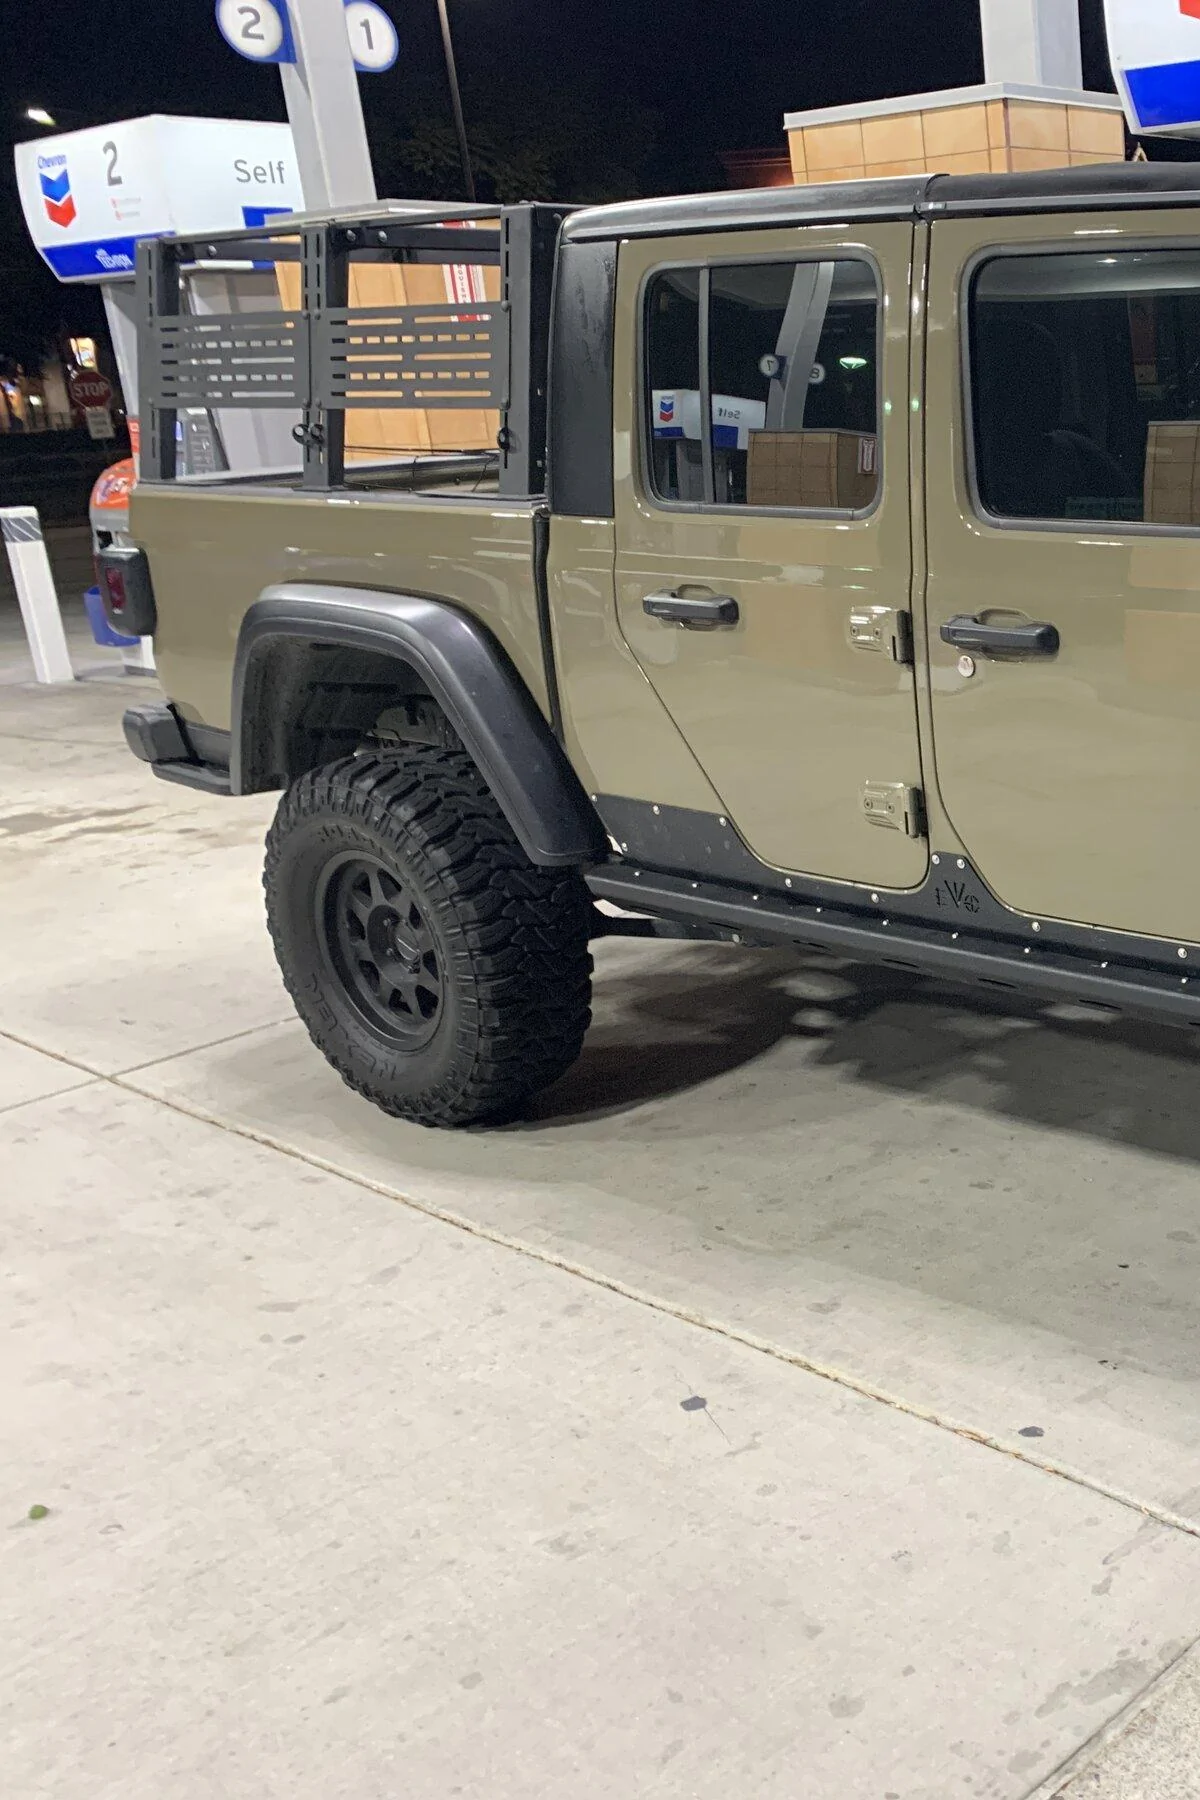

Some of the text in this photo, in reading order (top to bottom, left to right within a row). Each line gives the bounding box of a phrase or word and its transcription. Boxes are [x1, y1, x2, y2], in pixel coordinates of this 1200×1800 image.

[237, 6, 265, 41] 2
[359, 18, 375, 51] 1
[37, 154, 67, 169] Chevron
[102, 141, 123, 187] 2
[233, 158, 285, 184] Self
[74, 381, 109, 397] STOP
